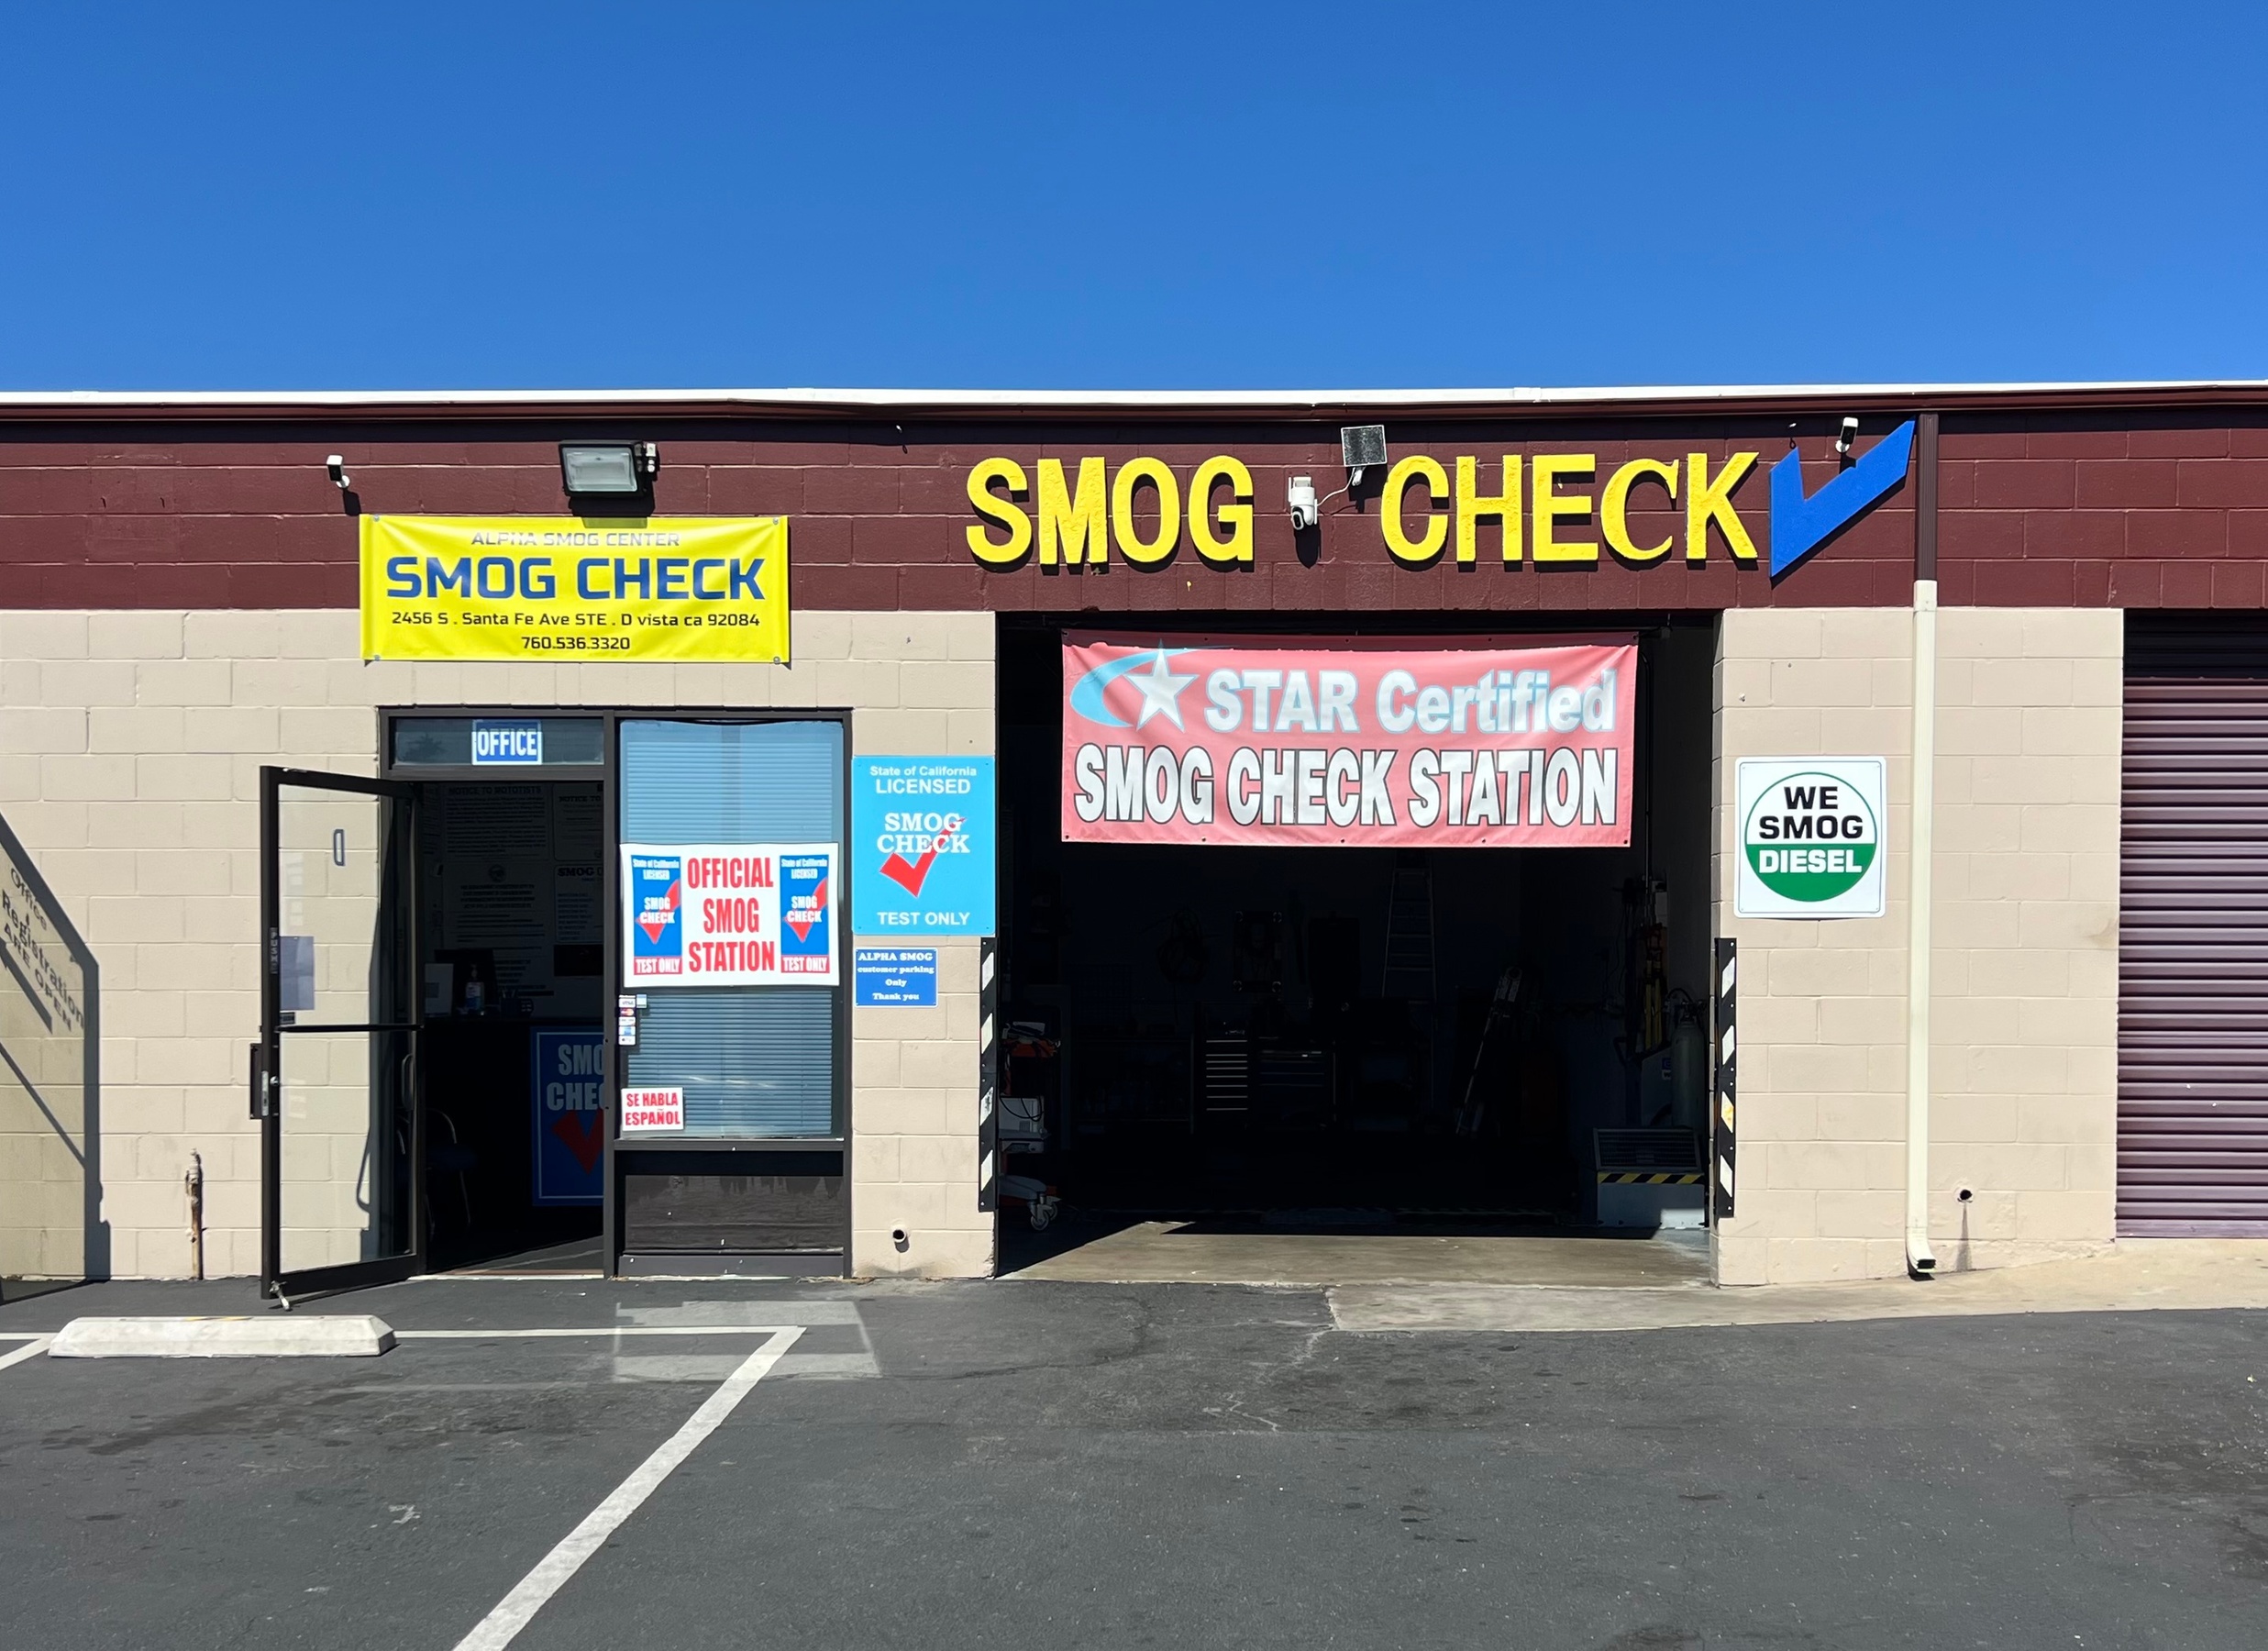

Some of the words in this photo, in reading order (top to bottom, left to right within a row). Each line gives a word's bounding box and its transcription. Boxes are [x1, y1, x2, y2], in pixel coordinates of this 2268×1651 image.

[967, 455, 1254, 565] SMOG
[1382, 452, 1759, 561] CHECK
[471, 532, 537, 546] ALPHA
[544, 533, 599, 547] SMOG
[606, 532, 680, 547] CENTER
[386, 557, 556, 599] SMOG
[577, 558, 766, 600] CHECK
[392, 612, 432, 624] 2456
[462, 613, 509, 625] Santa
[514, 614, 534, 625] Fe
[539, 614, 570, 625] Ave
[575, 614, 607, 626] STE
[622, 615, 632, 626] D
[637, 614, 679, 626] vista
[684, 616, 703, 626] ca
[708, 615, 760, 626] 92084
[521, 637, 630, 649] 760.536.3320
[1203, 669, 1361, 734] STAR
[1375, 669, 1618, 733] Certified
[477, 728, 537, 756] OFFICE
[870, 766, 901, 776] State
[904, 766, 916, 776] of
[919, 765, 977, 776] California
[876, 779, 970, 794] LICENSED
[1073, 744, 1215, 825] SMOG
[1226, 747, 1398, 827] CHECK
[1406, 747, 1618, 826] STATION
[1784, 786, 1838, 810] WE
[884, 813, 962, 832] SMOG
[1759, 815, 1864, 839] SMOG
[877, 834, 970, 854] CHECK
[1759, 849, 1863, 873] DIESEL
[558, 867, 594, 876] SMOG
[687, 857, 774, 889] OFFICIAL
[644, 897, 670, 910] SMOG
[791, 895, 817, 909] SMOG
[640, 911, 675, 924] CHECK
[703, 897, 759, 934] SMOG
[786, 911, 822, 923] CHECK
[877, 912, 920, 925] TEST
[924, 912, 970, 925] ONLY
[689, 940, 774, 972] STATION
[857, 952, 898, 961] ALPHA
[900, 953, 934, 961] SMOG
[636, 958, 658, 973] TEST
[658, 958, 680, 972] ONLY
[783, 958, 804, 972] TEST
[806, 957, 827, 971] ONLY
[899, 966, 935, 974] parking
[885, 979, 907, 987] Only
[626, 1093, 639, 1107] SE
[642, 1092, 678, 1106] HABLA
[625, 1108, 680, 1125] ESPAÑOL
